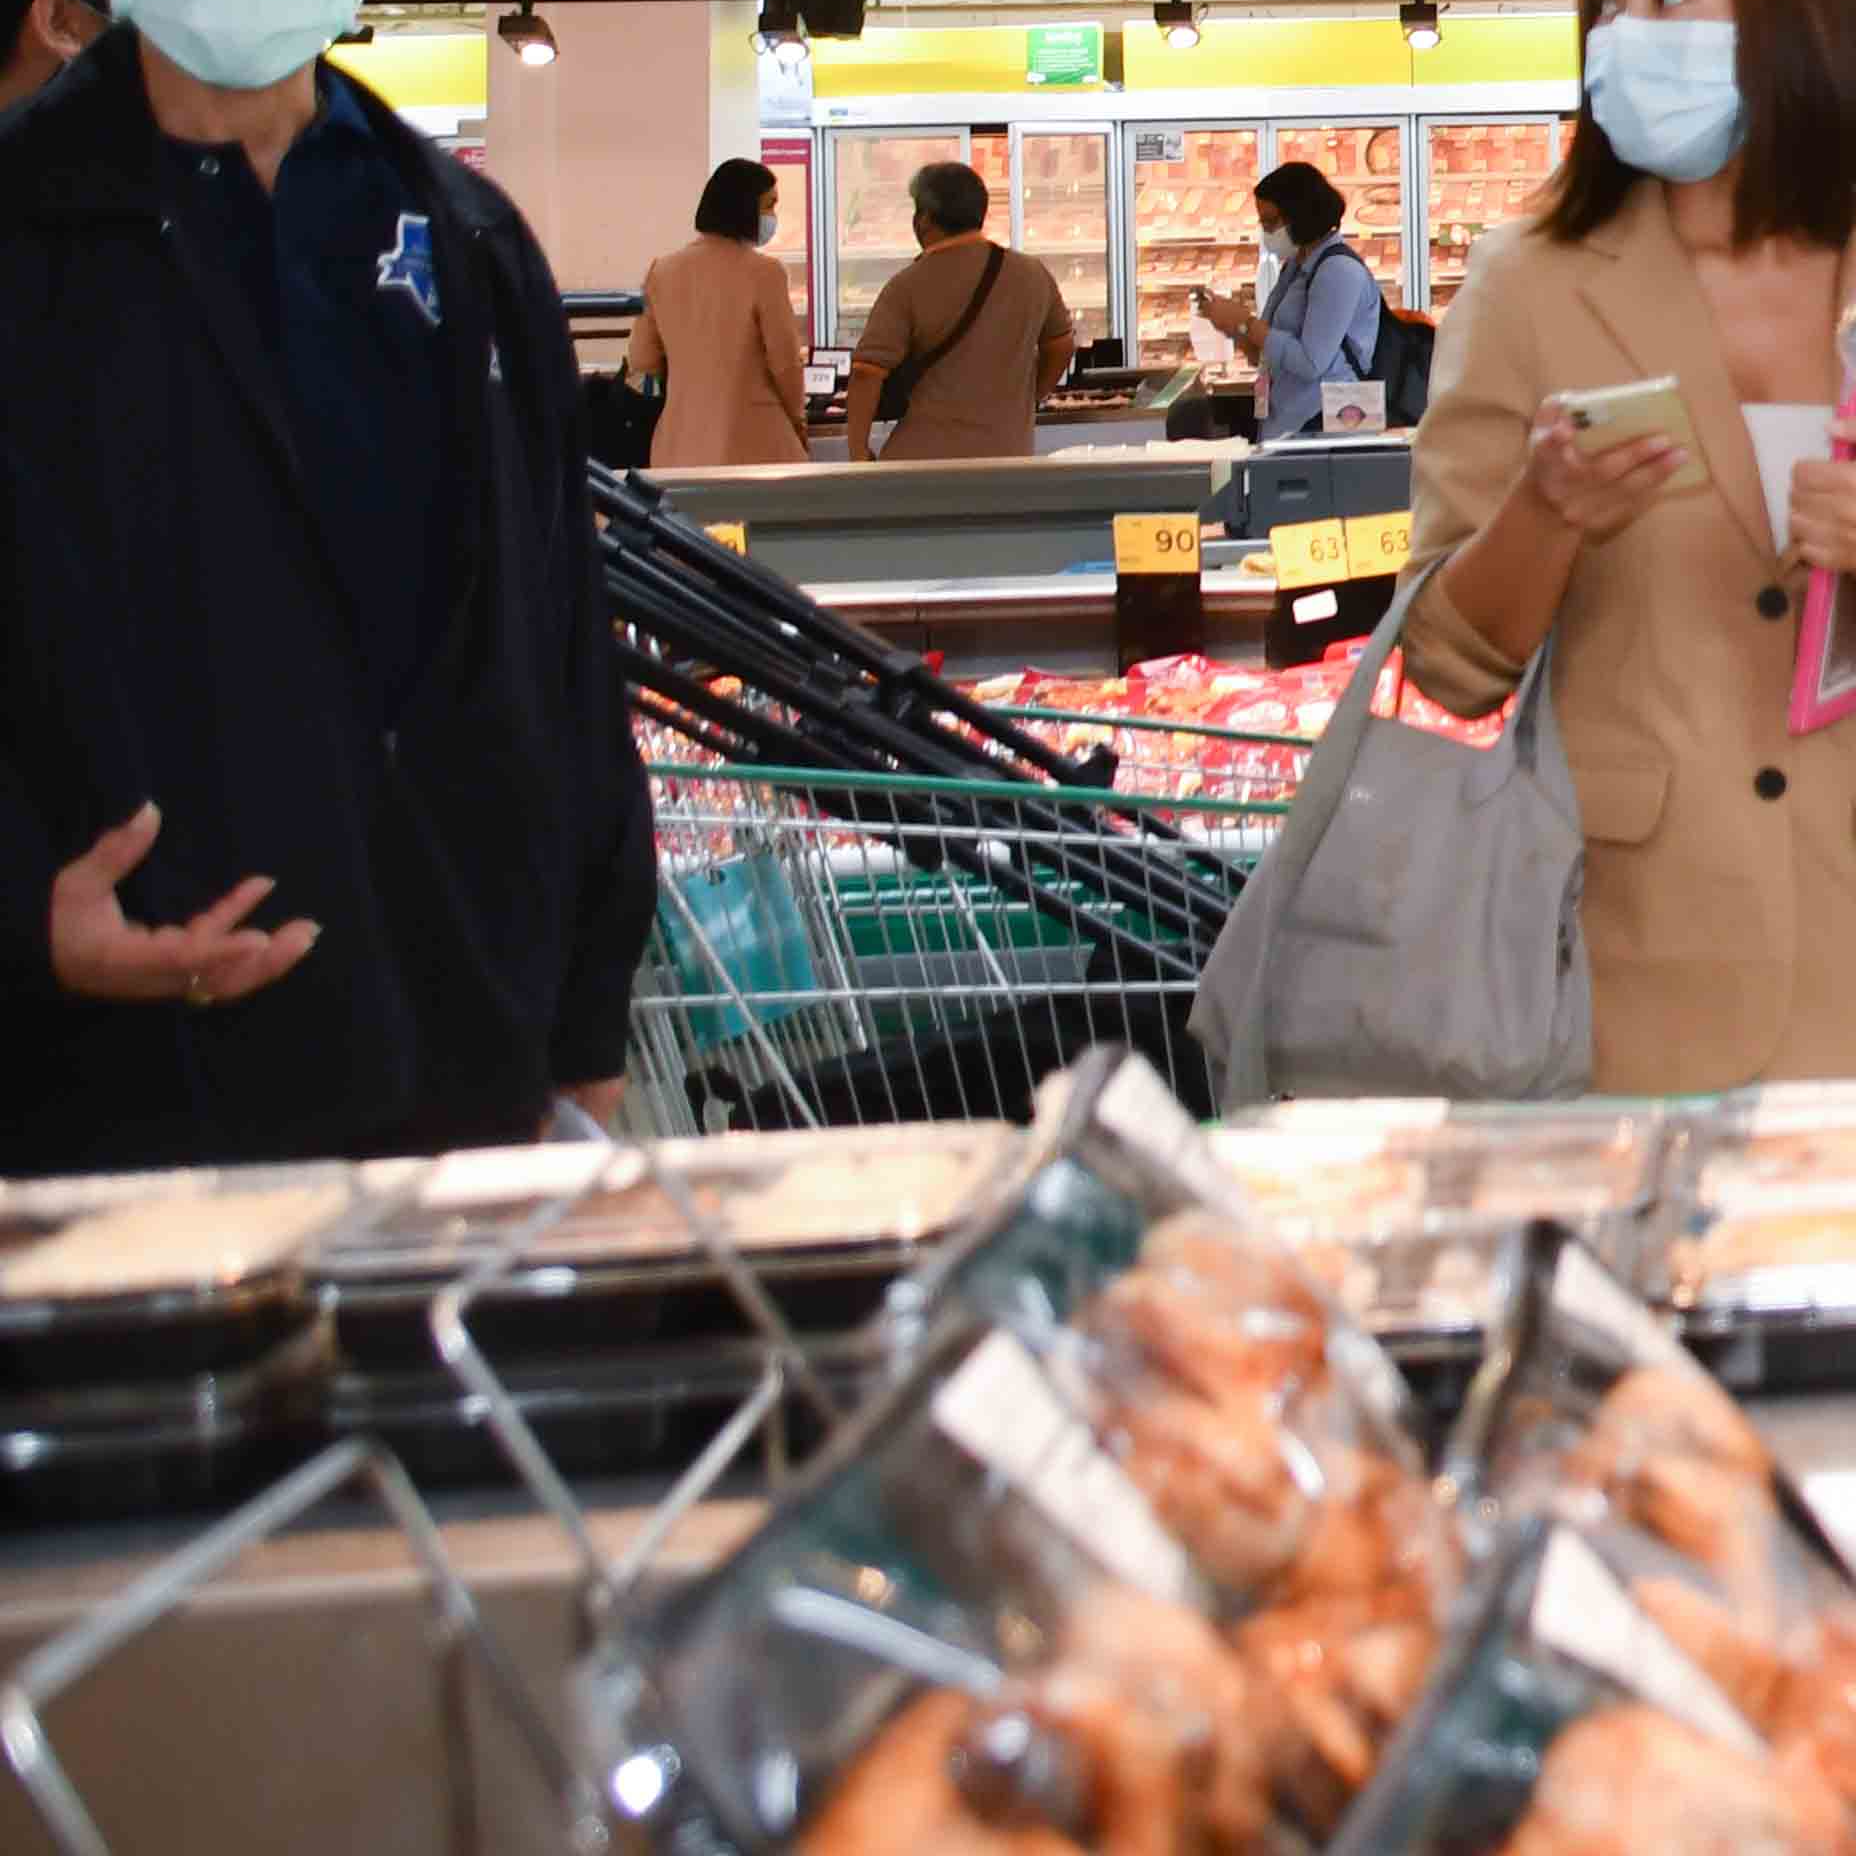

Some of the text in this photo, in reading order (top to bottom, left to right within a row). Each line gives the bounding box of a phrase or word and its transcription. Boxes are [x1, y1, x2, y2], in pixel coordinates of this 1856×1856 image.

[1154, 529, 1195, 554] 90
[1310, 536, 1340, 562] 63
[1380, 528, 1410, 555] 63
